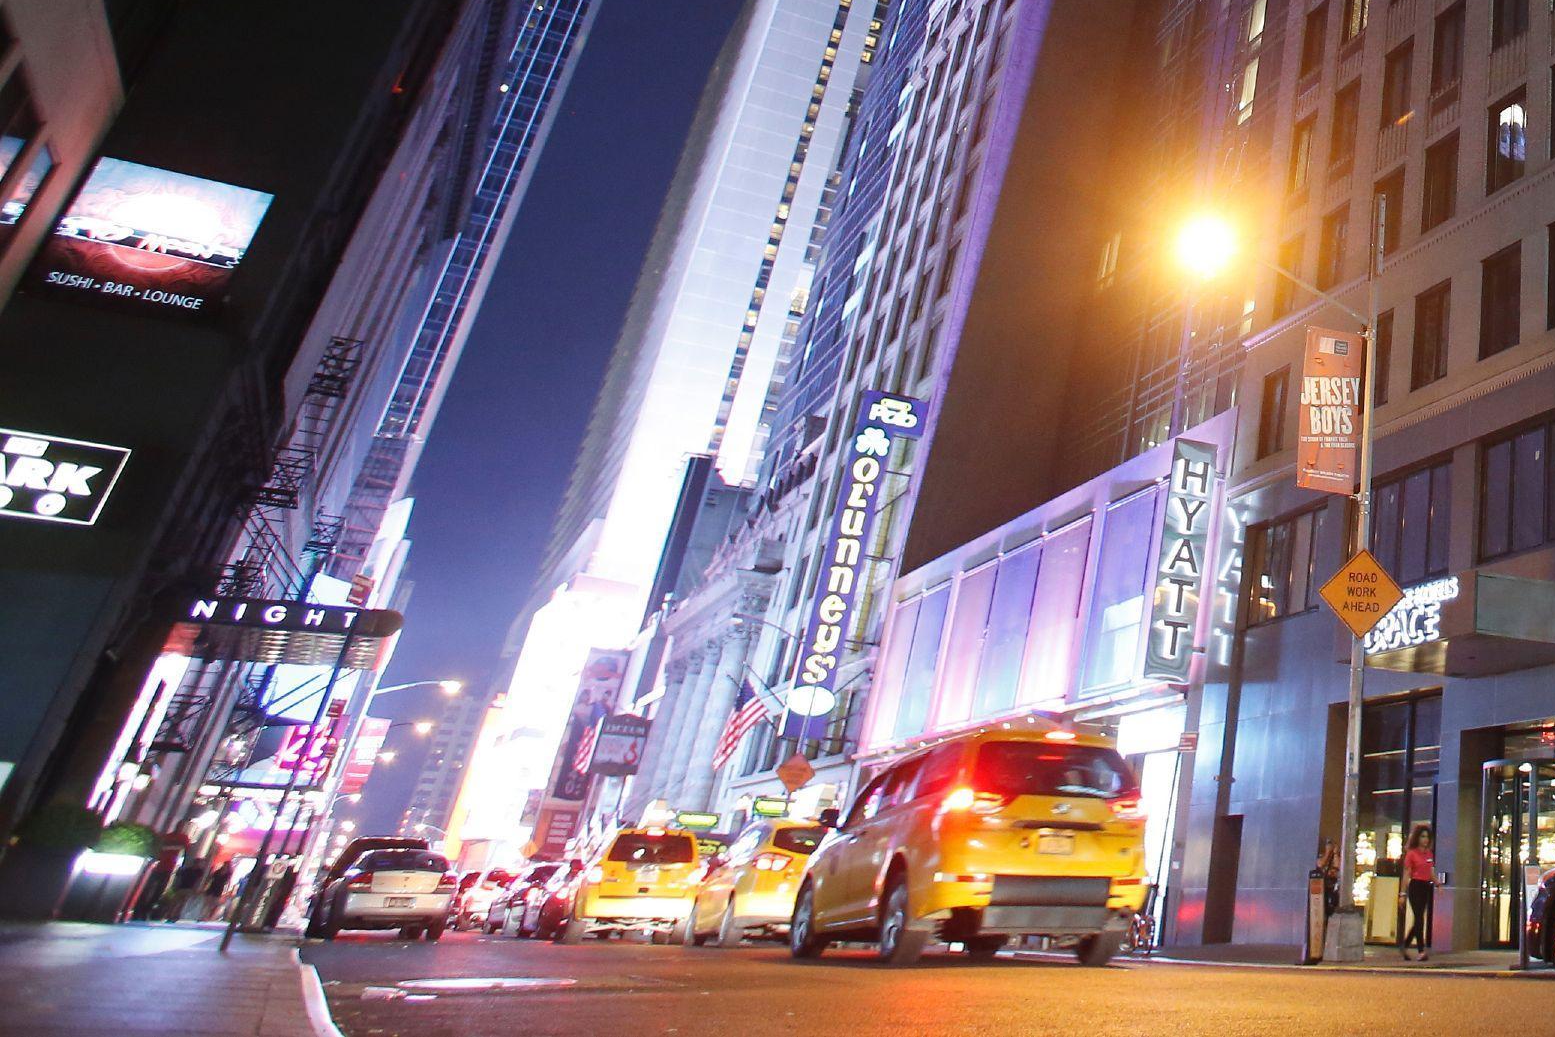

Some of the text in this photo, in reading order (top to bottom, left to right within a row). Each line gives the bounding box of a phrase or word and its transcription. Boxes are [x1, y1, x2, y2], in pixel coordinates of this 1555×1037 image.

[45, 271, 204, 310] SUSHI BAR LOUNGE
[1300, 376, 1361, 406] JERSEY
[1310, 405, 1353, 435] BOYS
[1160, 458, 1211, 658] HYATT
[1347, 586, 1377, 598] WORK
[1348, 572, 1378, 583] ROAD
[191, 600, 358, 629] NIGHT
[1342, 601, 1380, 613] AHEAD
